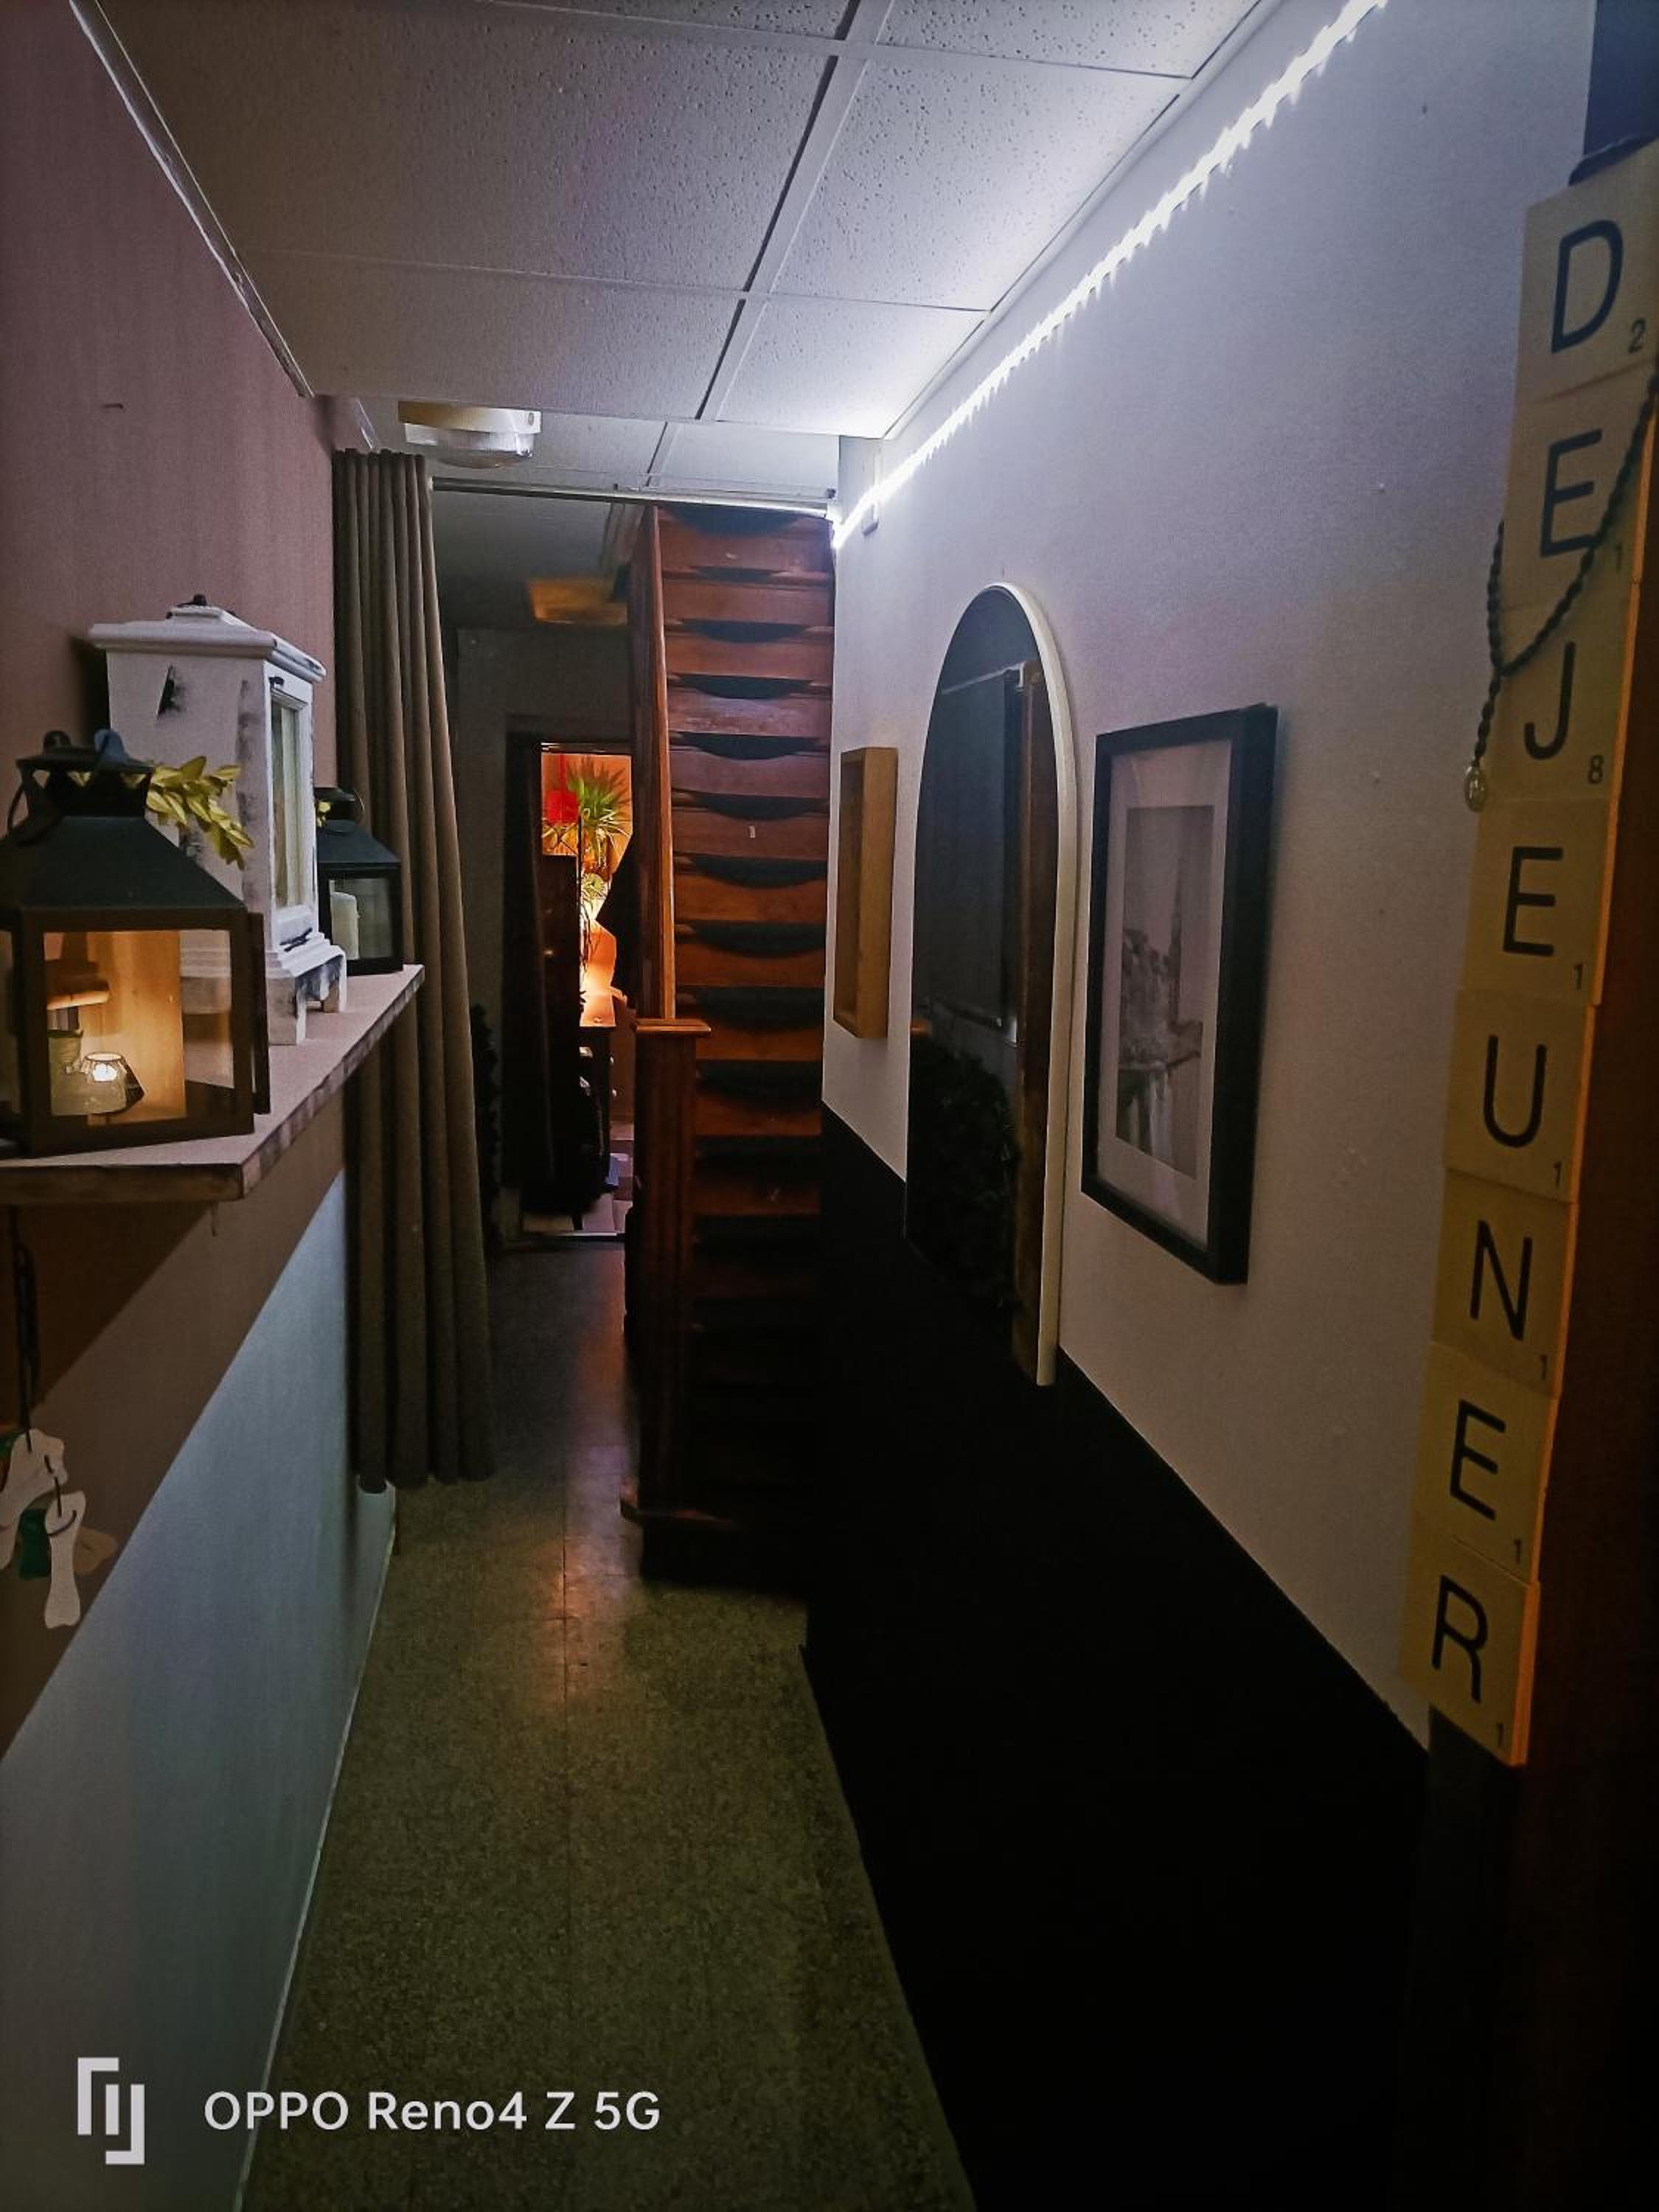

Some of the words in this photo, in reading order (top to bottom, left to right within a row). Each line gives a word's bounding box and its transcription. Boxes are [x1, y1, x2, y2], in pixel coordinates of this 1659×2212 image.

[1628, 318, 1646, 354] 2
[1587, 754, 1604, 785] 8
[1432, 220, 1622, 1703] DEJEUNER
[1572, 962, 1584, 990] 1
[1553, 1162, 1562, 1187] 1
[1539, 1355, 1548, 1380] 1
[1512, 1538, 1522, 1565] 1
[1496, 1722, 1505, 1750] 1
